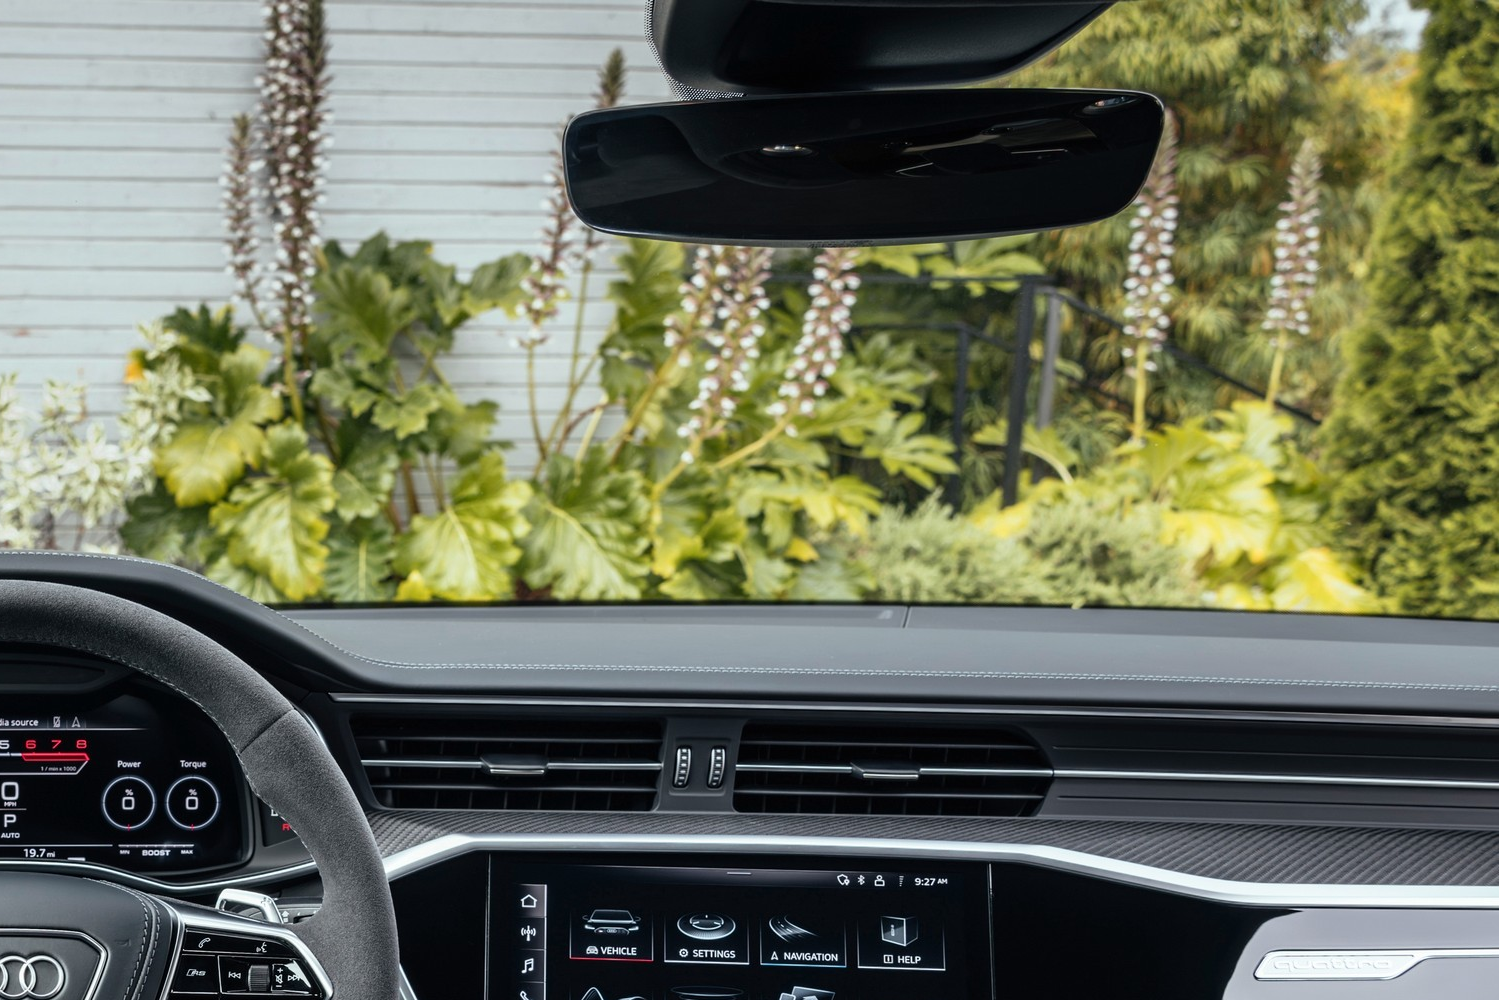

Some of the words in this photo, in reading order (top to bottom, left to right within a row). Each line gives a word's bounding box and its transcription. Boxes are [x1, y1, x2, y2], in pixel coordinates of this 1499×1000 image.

[11, 718, 38, 727] source
[0, 740, 10, 749] 5
[26, 740, 36, 749] 6
[52, 740, 61, 749] 7
[77, 740, 87, 749] 8
[117, 760, 141, 768] Power
[180, 760, 207, 769] Torque
[1, 782, 19, 800] 0
[122, 797, 135, 810] 0
[185, 797, 198, 810] 0
[4, 814, 16, 828] P
[915, 877, 936, 887] 9:27
[601, 946, 637, 956] VEHICLE
[692, 949, 736, 959] SETTINGS
[784, 952, 838, 962] NAVIGATION
[897, 955, 922, 965] HELP
[1274, 959, 1392, 973] quattro
